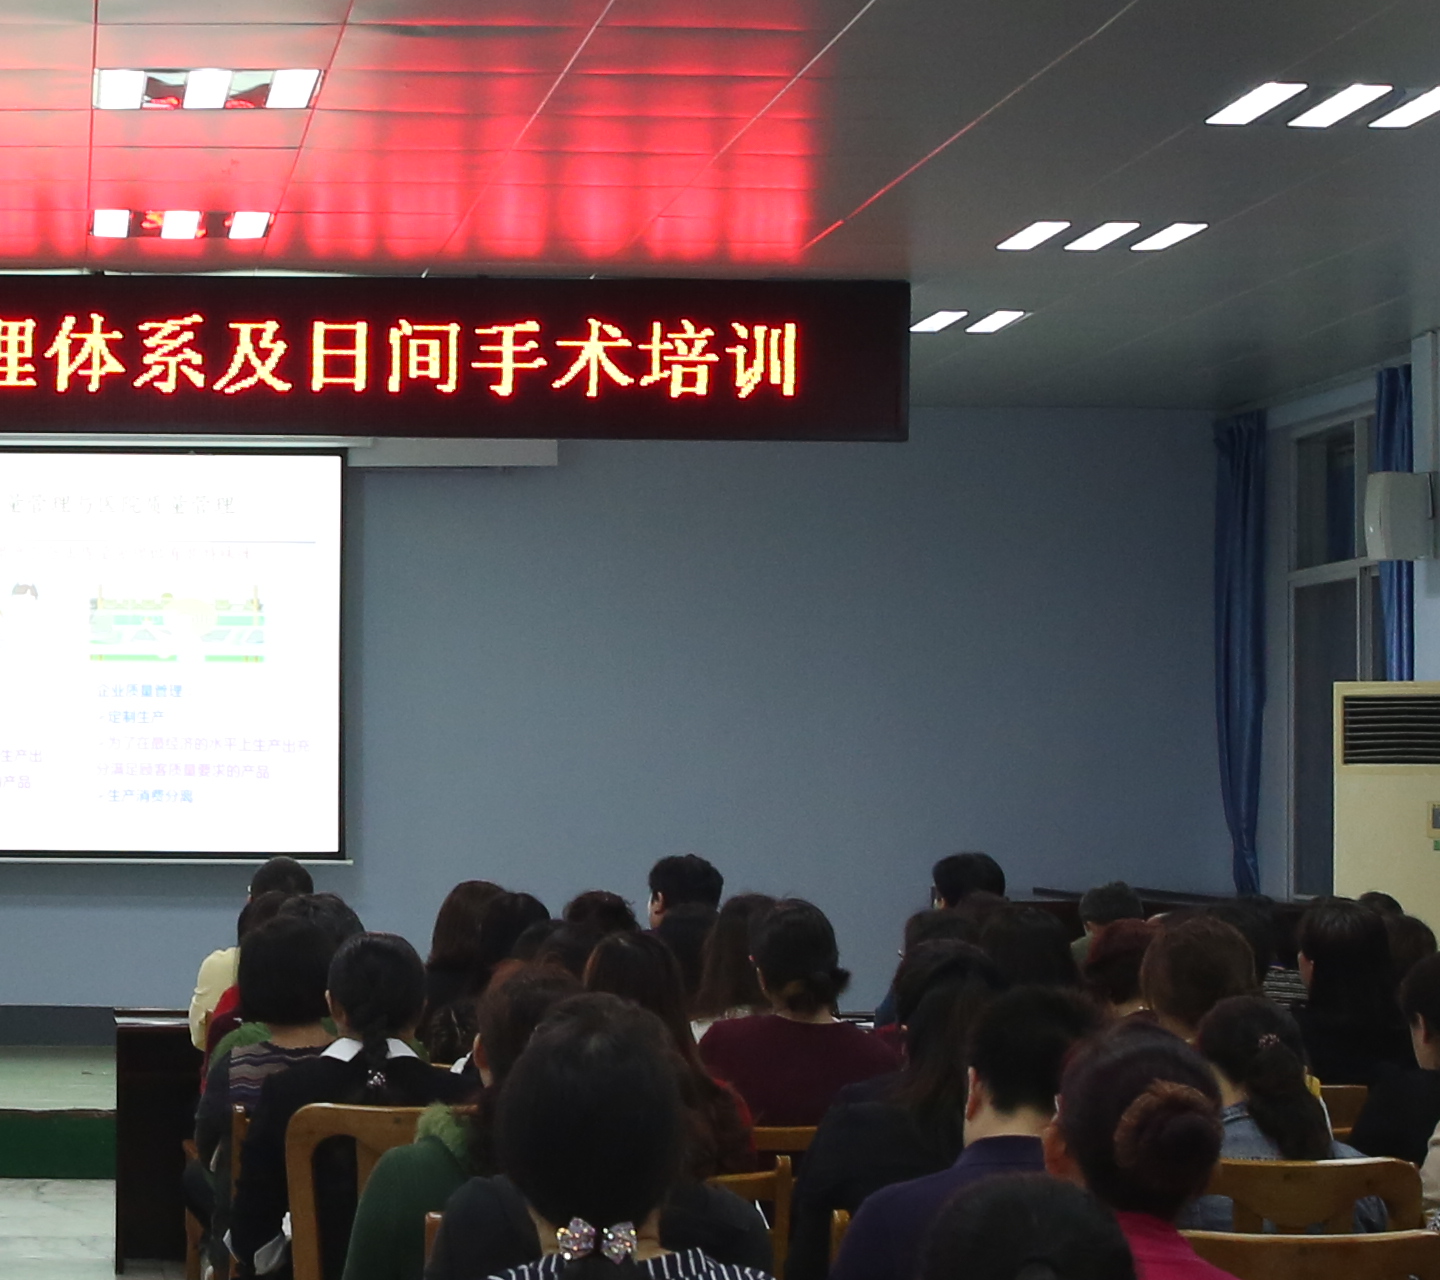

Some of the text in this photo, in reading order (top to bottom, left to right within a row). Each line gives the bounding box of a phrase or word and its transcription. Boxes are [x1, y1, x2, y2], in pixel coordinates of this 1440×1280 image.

[108, 710, 165, 724] 定制生产
[108, 736, 310, 753] 为了在最经济的水平上生产出充
[97, 762, 270, 779] 分满足顾客质量要求的产品
